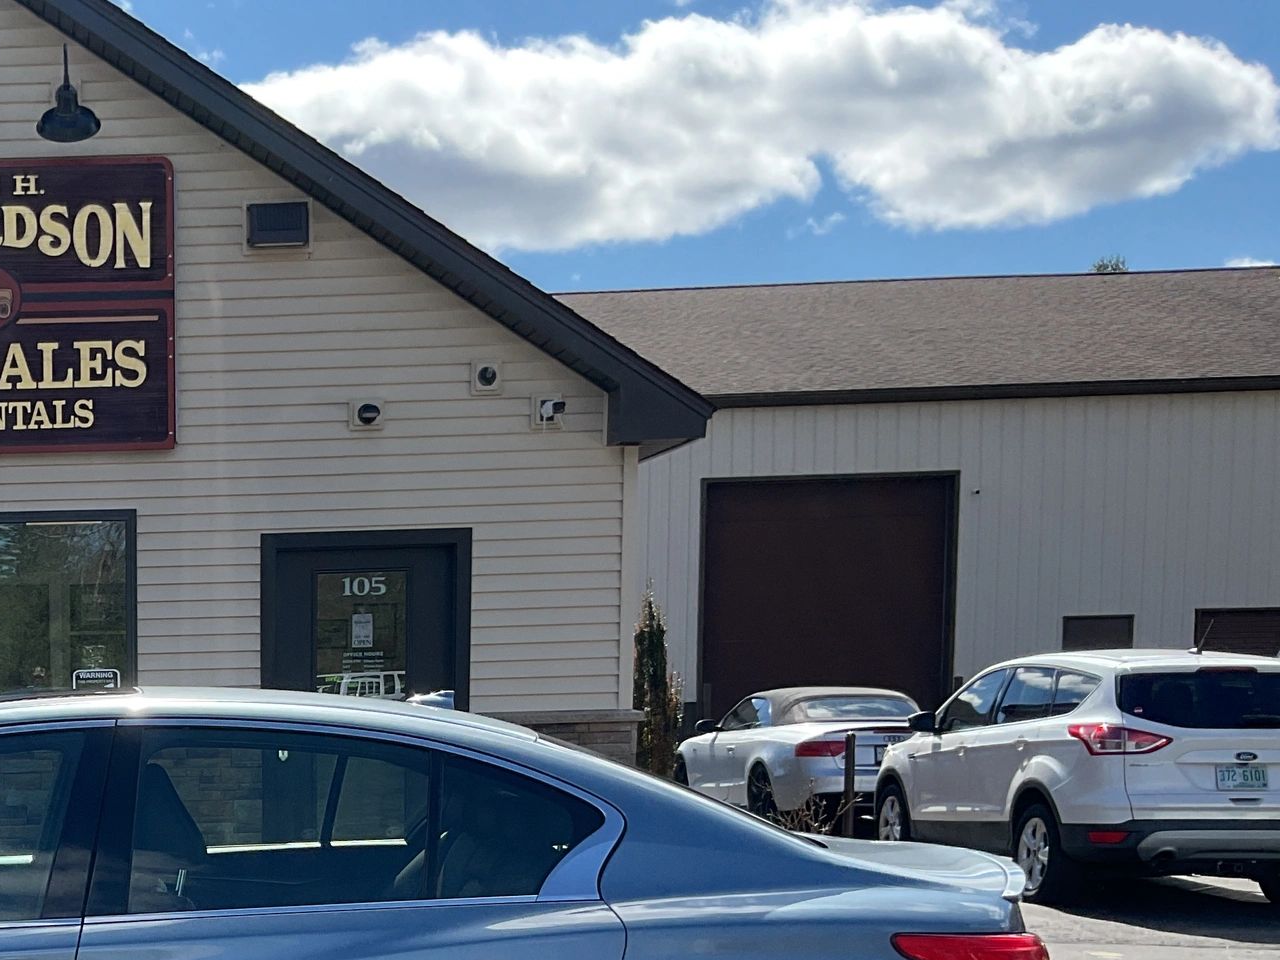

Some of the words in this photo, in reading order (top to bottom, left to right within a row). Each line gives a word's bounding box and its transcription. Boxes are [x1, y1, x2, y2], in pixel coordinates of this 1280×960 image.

[13, 175, 45, 196] H.
[341, 576, 387, 596] 105
[1242, 769, 1266, 782] 6101
